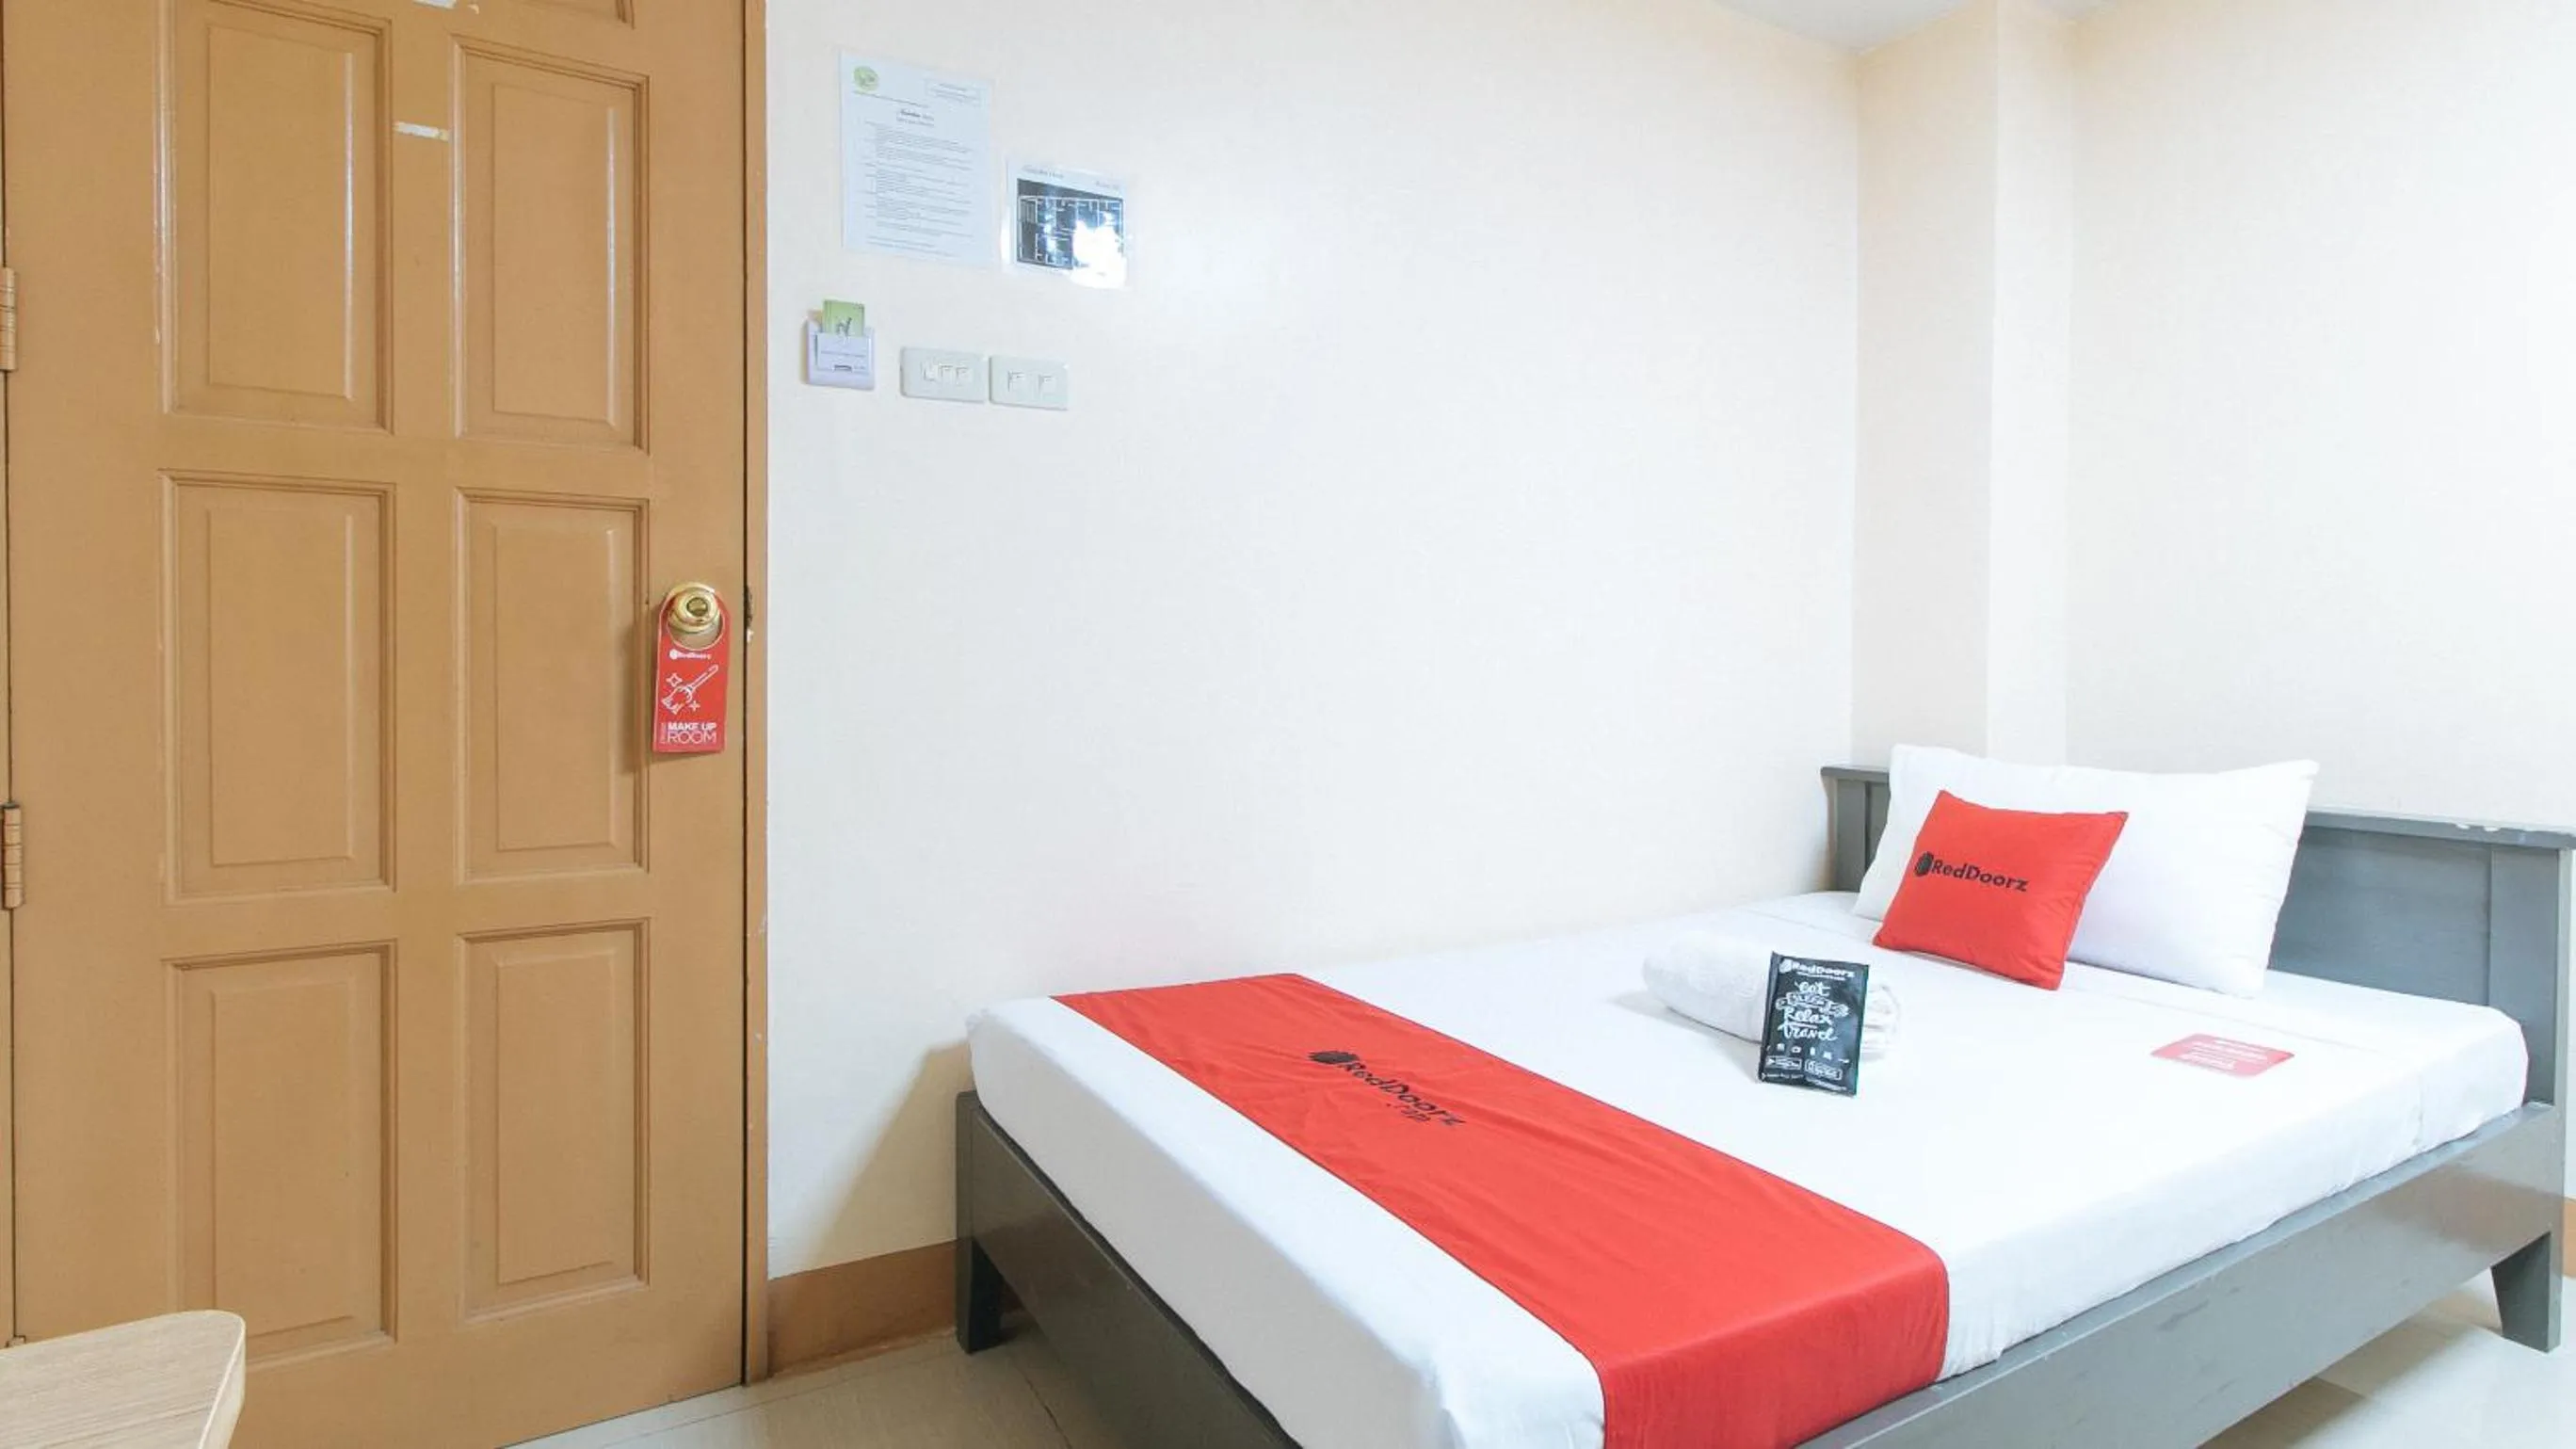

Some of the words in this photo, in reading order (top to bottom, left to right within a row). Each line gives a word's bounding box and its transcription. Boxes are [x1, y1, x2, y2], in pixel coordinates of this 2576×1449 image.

[668, 722, 699, 732] MAKE
[701, 722, 716, 732] UP
[668, 732, 716, 745] ROOM
[1932, 859, 2029, 892] RedDoorz
[1792, 961, 1855, 977] RedDoorz
[1784, 1006, 1833, 1025] Relax
[1338, 1061, 1466, 1125] RedDoorz
